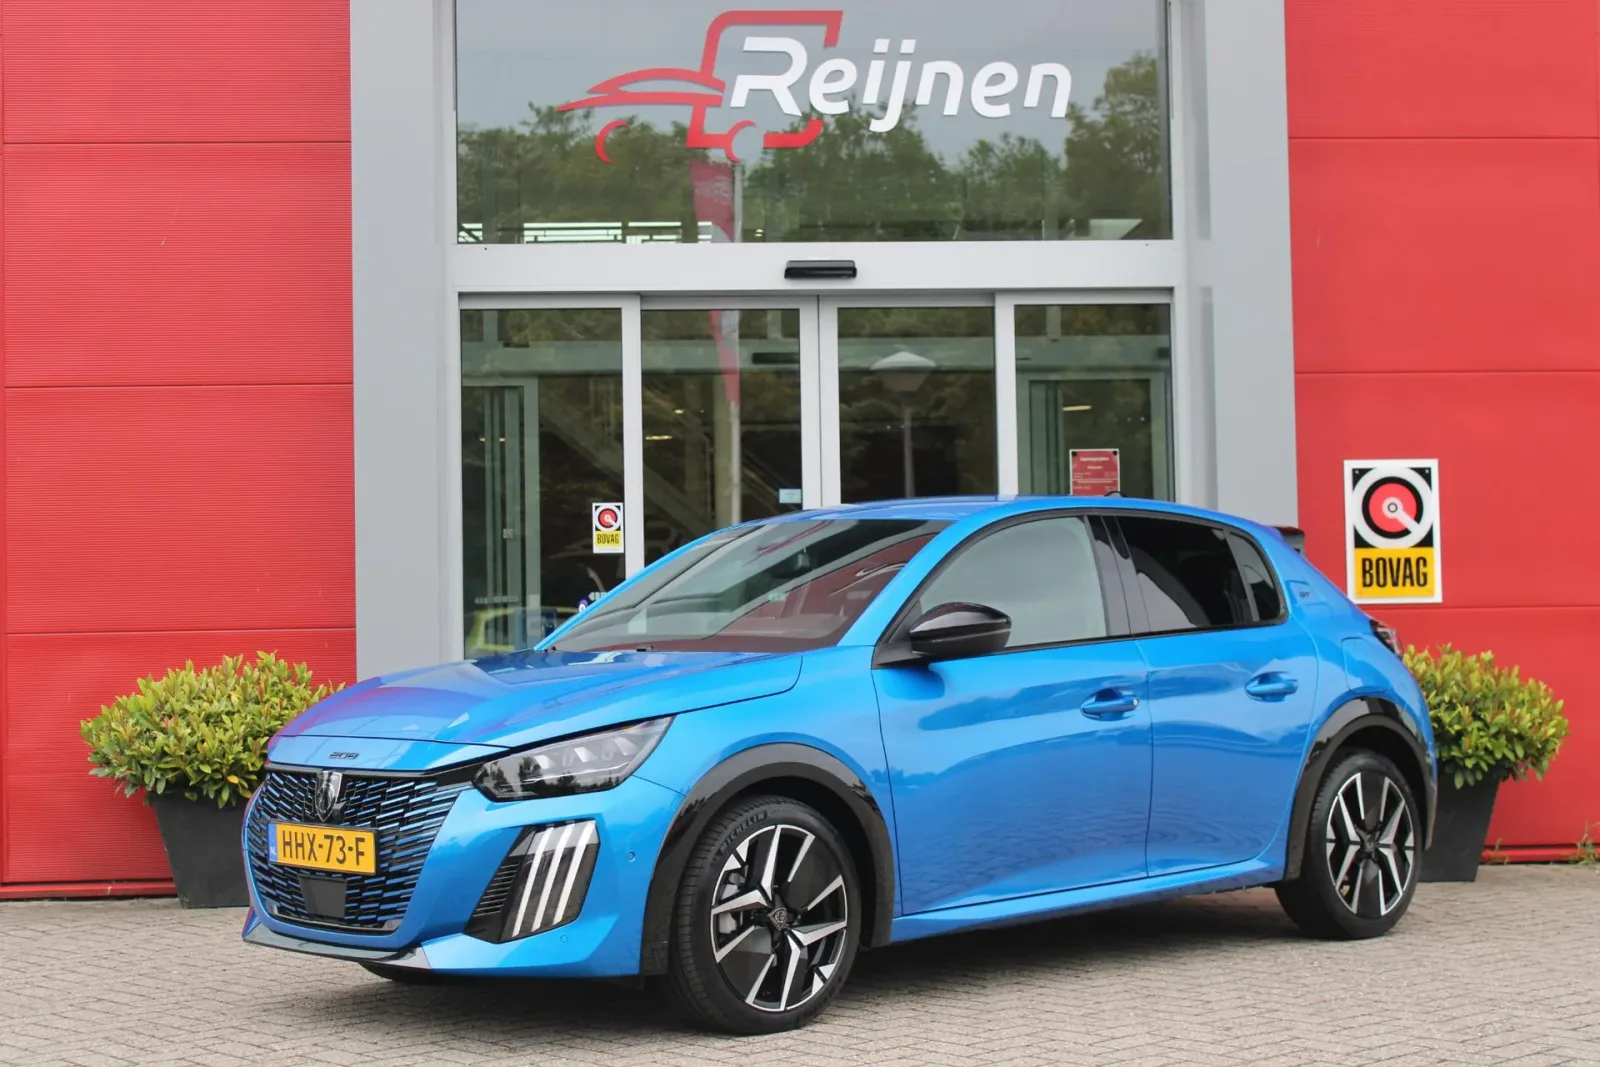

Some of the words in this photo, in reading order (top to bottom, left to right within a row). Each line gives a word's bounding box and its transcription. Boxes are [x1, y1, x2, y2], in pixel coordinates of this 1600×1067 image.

[729, 36, 1072, 132] Reijnen
[596, 533, 620, 544] BOVAG
[1361, 556, 1428, 588] BOVAG
[281, 830, 366, 866] HHX-73-F
[719, 811, 766, 854] MICHELIN
